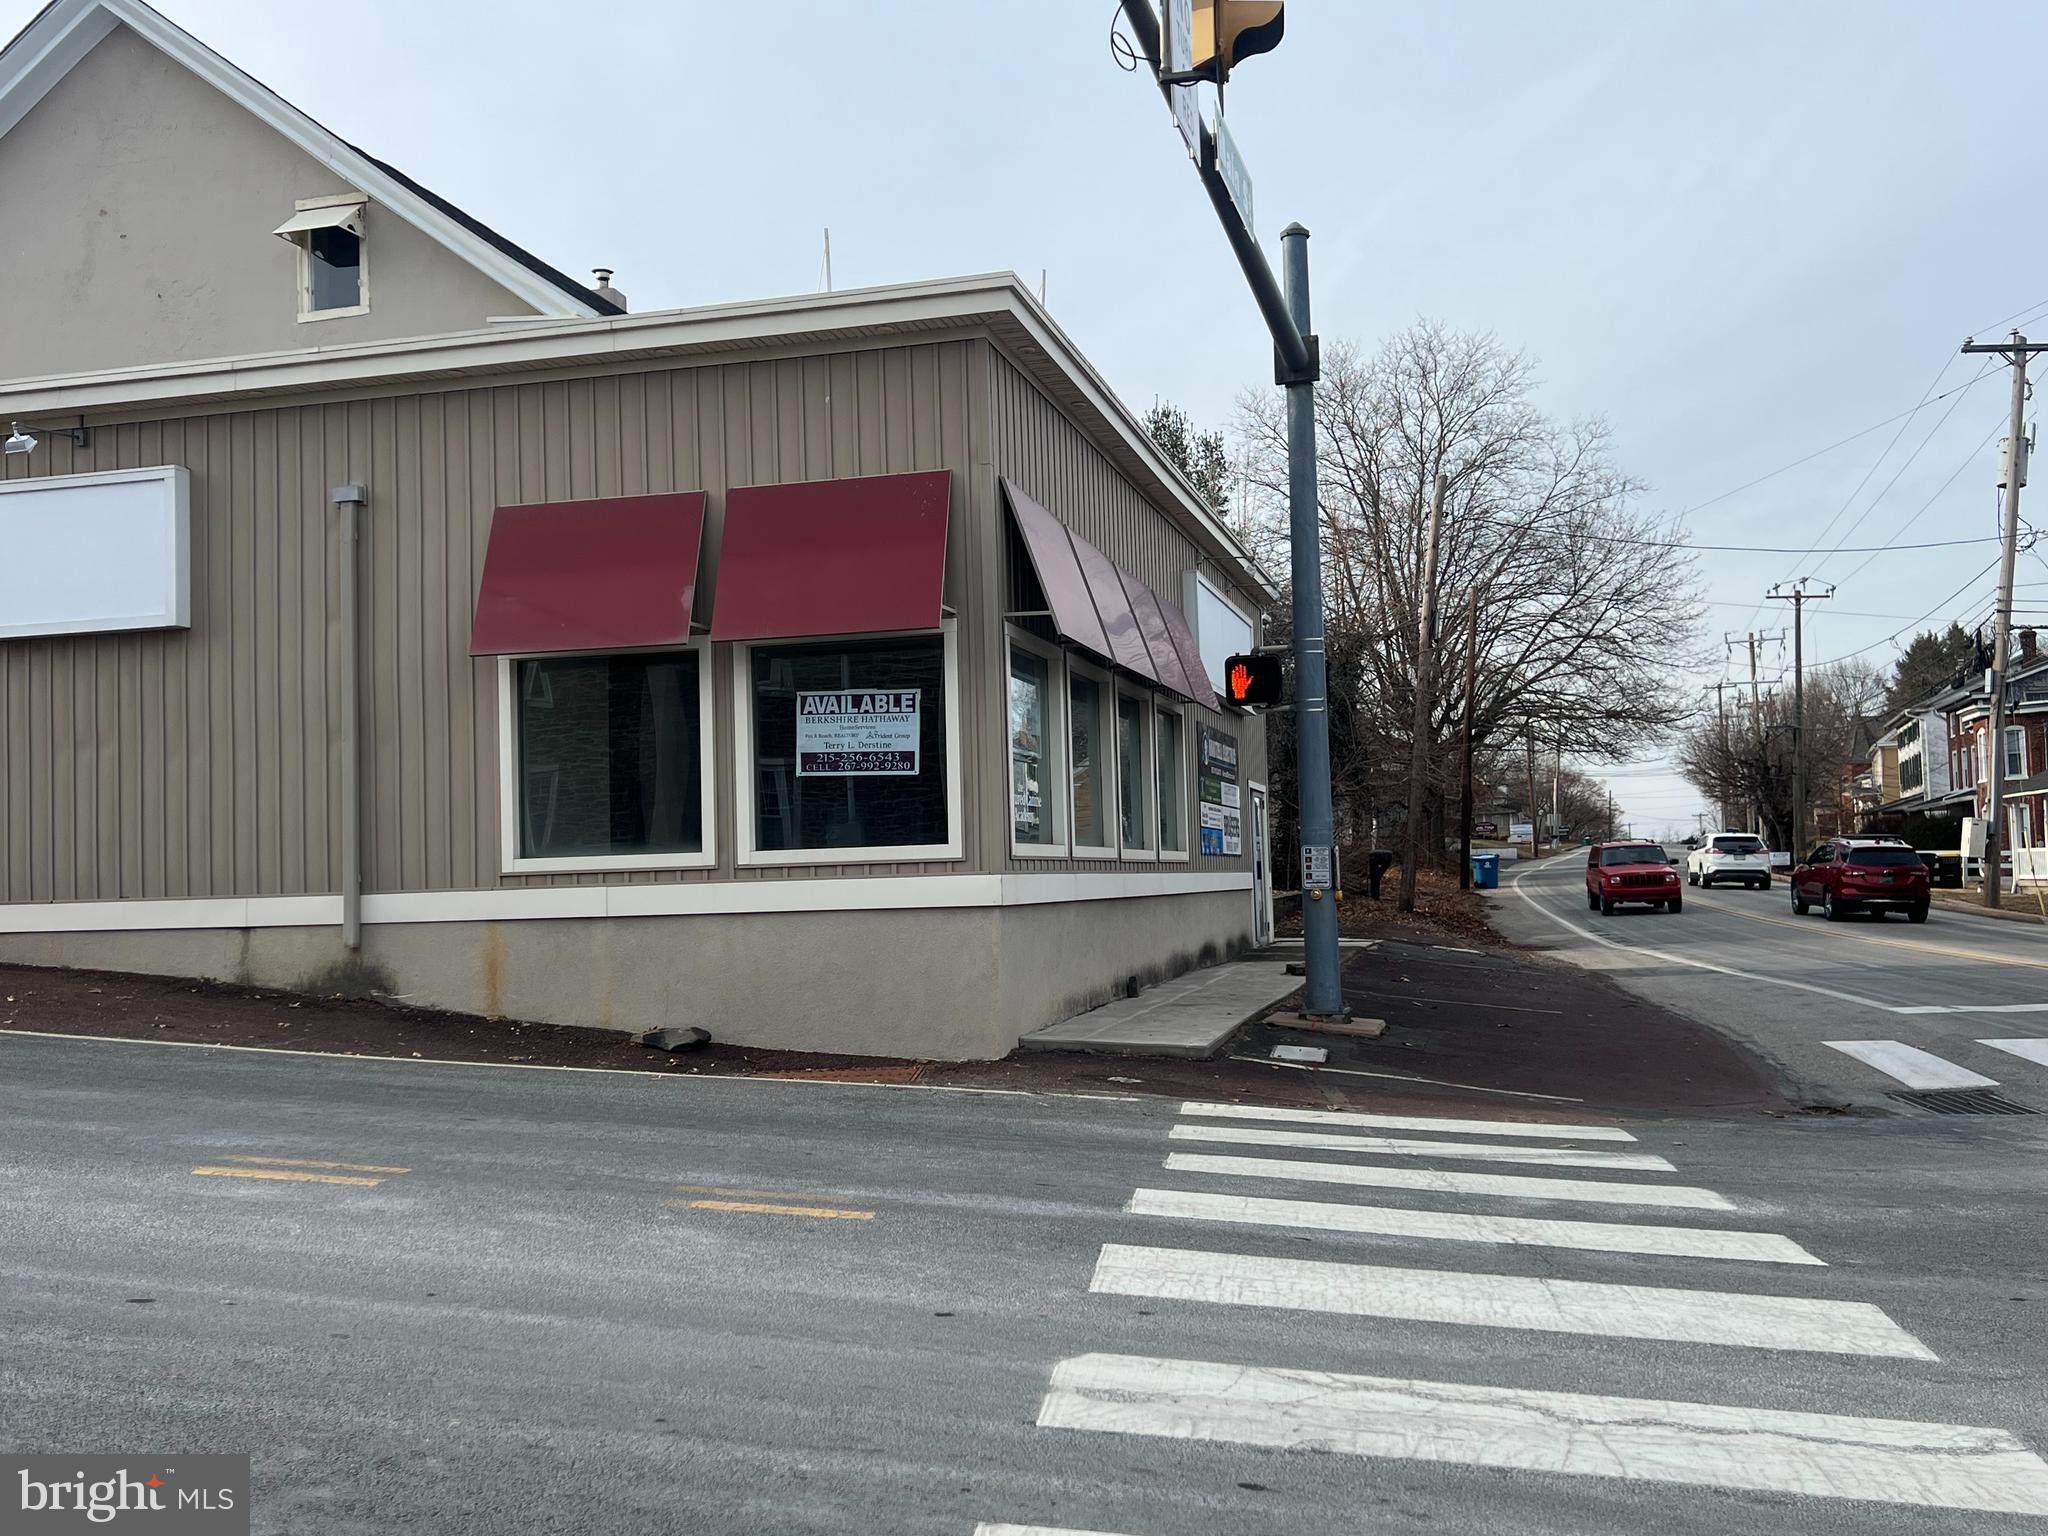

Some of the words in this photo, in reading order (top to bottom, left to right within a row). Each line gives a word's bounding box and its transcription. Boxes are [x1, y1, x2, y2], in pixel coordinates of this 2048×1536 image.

[803, 695, 913, 714] AVAILABLE
[805, 716, 859, 724] BERKSHIRE
[861, 715, 911, 723] HATHAWAY
[824, 741, 845, 750] Terry
[858, 741, 892, 749] Derstine
[816, 753, 900, 763] 215-256-6543
[838, 762, 911, 771] 267-992-9280
